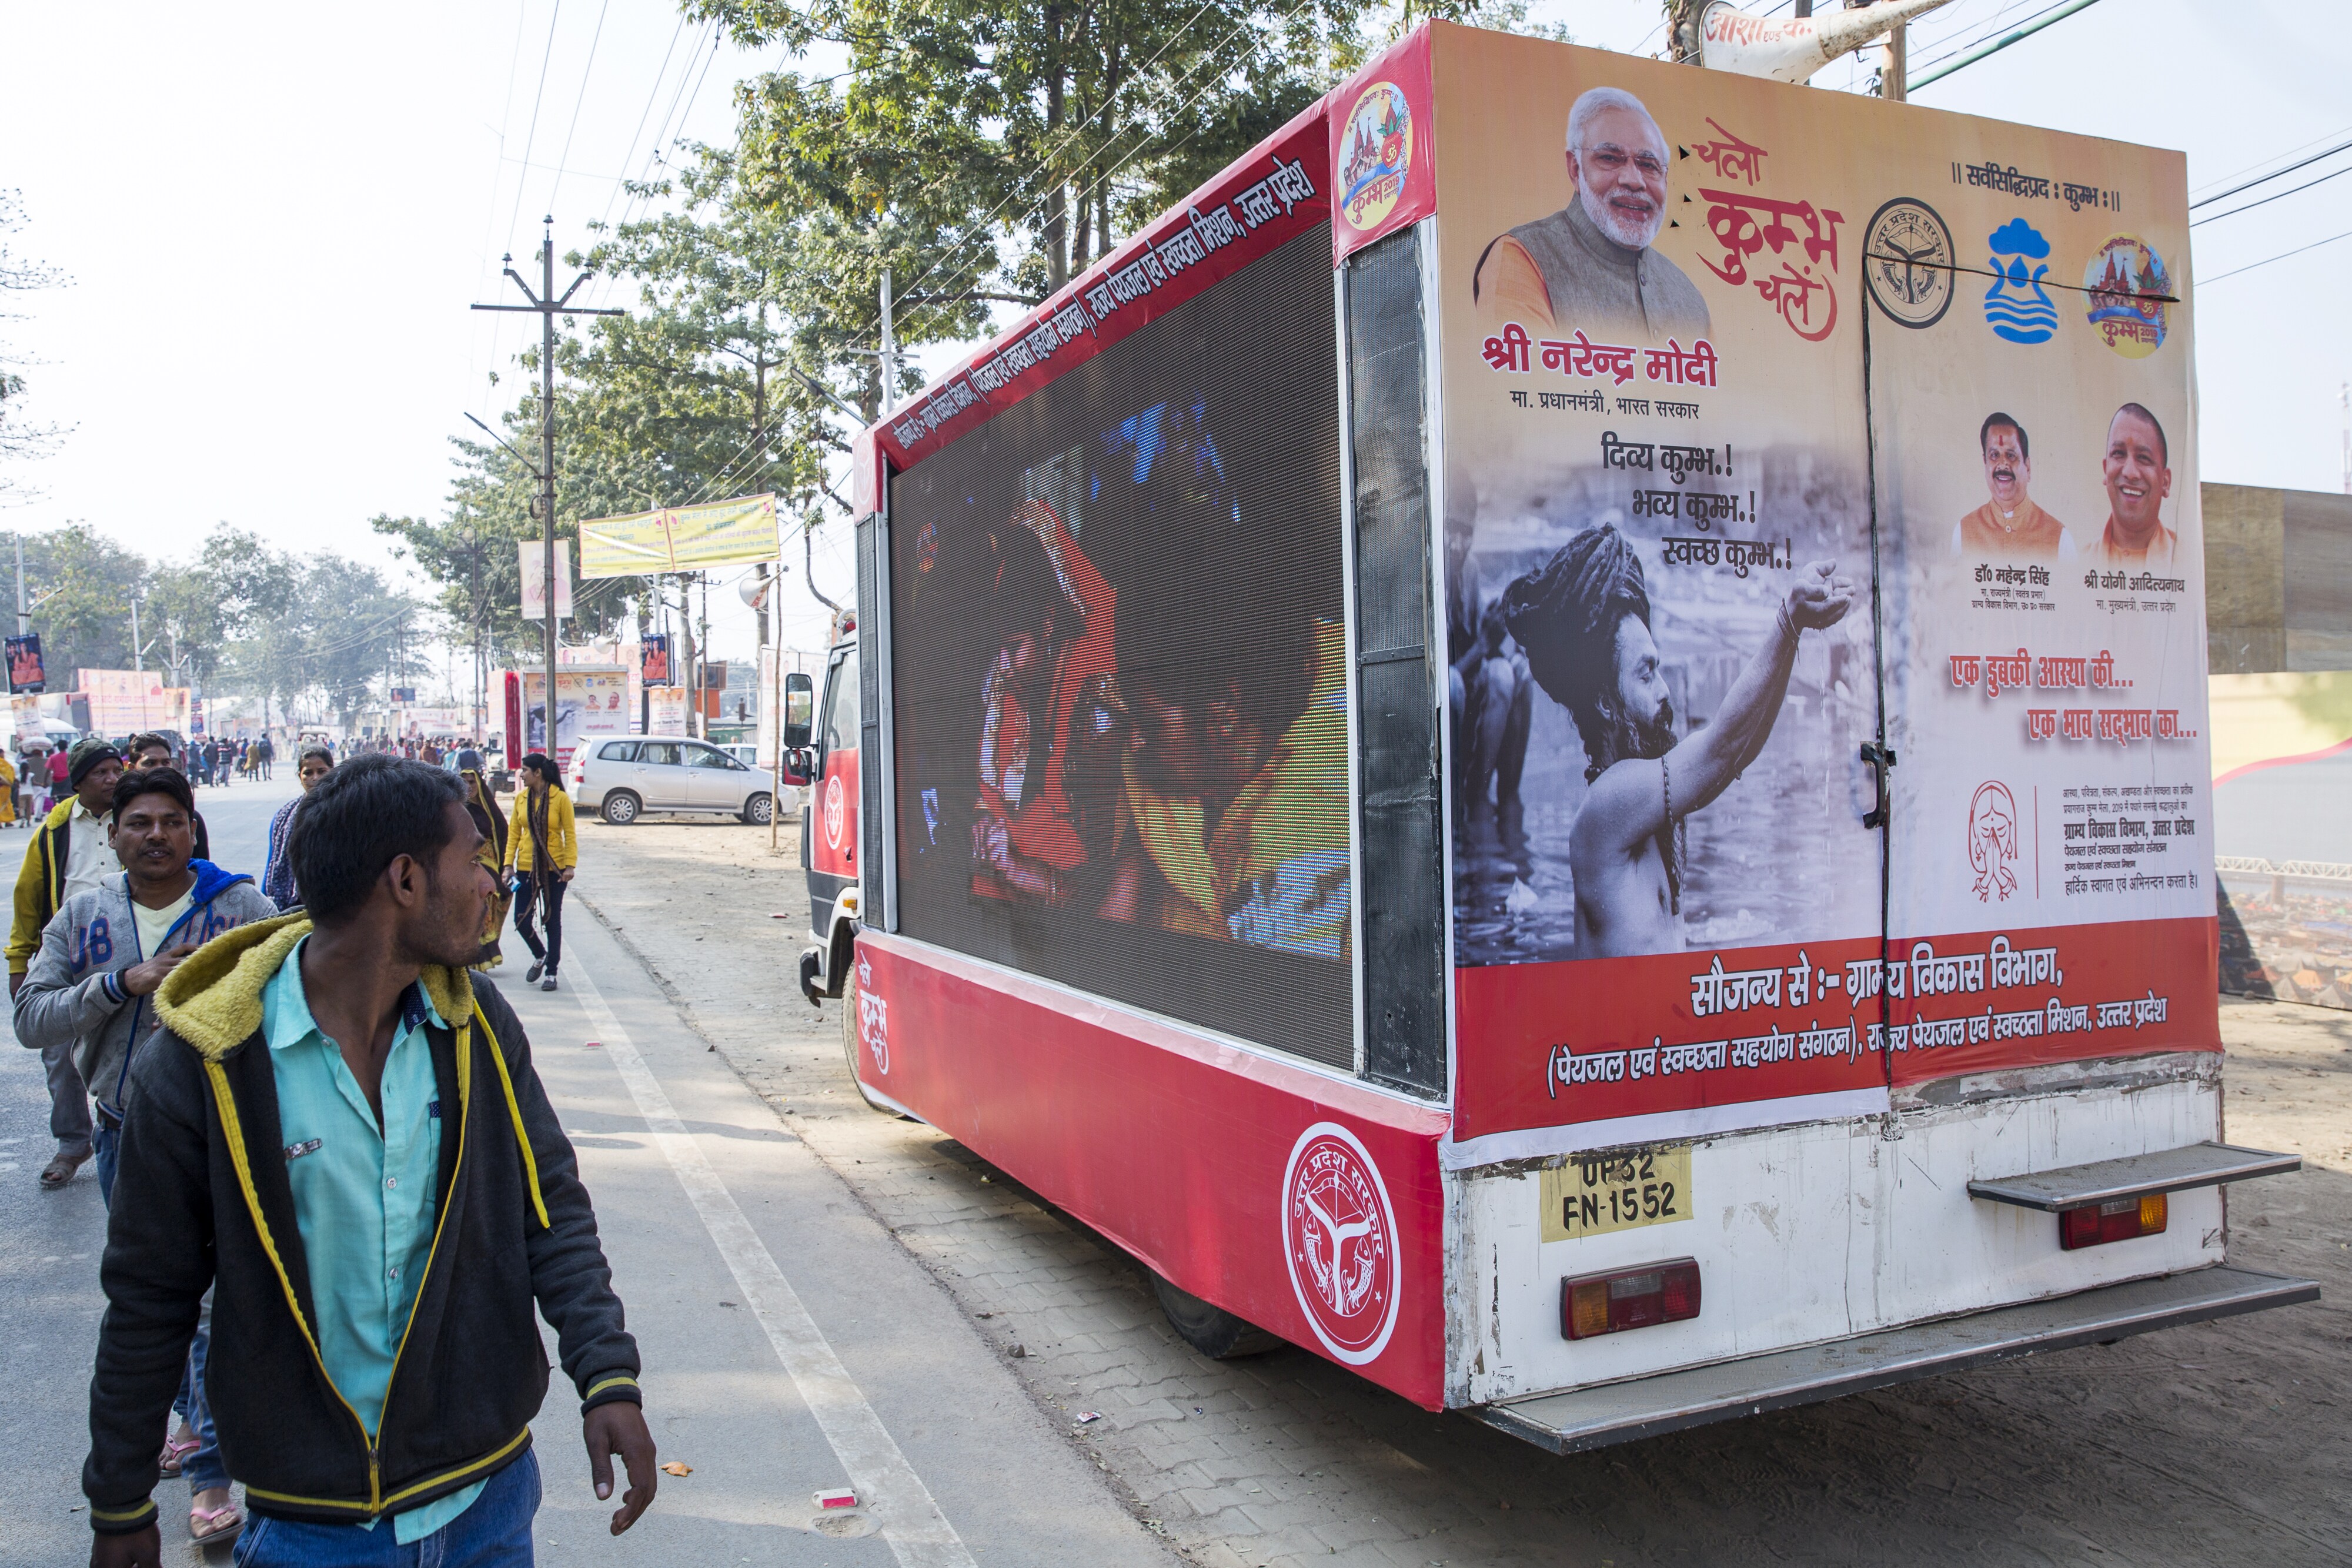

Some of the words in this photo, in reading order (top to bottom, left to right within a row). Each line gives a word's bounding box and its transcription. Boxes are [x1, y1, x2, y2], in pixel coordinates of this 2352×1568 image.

[1706, 11, 1765, 46] आशा
[1692, 118, 1768, 186] चलो
[1351, 172, 1390, 225] कुम्भ
[1384, 175, 1400, 193] 2019
[1696, 188, 1845, 286] कुम्भ
[1875, 224, 1890, 254] उत्तर
[1889, 210, 1920, 226] प्रदेश
[1923, 219, 1945, 263] सरकार
[927, 393, 960, 422] विकास
[1025, 315, 1063, 360] सहयोग
[1085, 284, 1115, 320] राज्य
[1104, 266, 1152, 305] पेयजल
[1140, 238, 1168, 288] एवं
[1188, 205, 1248, 254] मिशन,
[1233, 180, 1282, 230] उत्तर
[1268, 153, 1316, 218] प्रदेश
[1753, 262, 1838, 342] चलें
[2100, 319, 2145, 347] कुम्भ
[2140, 328, 2158, 337] 2019
[1481, 322, 1532, 374] श्री
[1540, 329, 1637, 387] नरेन्द्र
[1643, 339, 1719, 389] मोदी
[1509, 389, 1534, 410] मा.
[1538, 390, 1611, 415] प्रधानमंत्री,
[1616, 396, 1650, 417] भारत
[1655, 400, 1699, 420] सरकार
[1601, 431, 1655, 472] दिव्य
[1633, 489, 1680, 519] भव्य
[1662, 537, 1720, 566] स्वच्छ
[1996, 564, 2026, 586] महेन्द्र
[2029, 565, 2050, 586] सिंह
[2084, 569, 2098, 590] श्री
[2101, 570, 2126, 591] योगी
[2129, 571, 2185, 593] आदित्यनाथ
[1985, 597, 2001, 610] विकास
[2039, 603, 2056, 611] सरकार
[2096, 599, 2107, 611] मा.
[2141, 600, 2159, 613] उत्तर
[2159, 599, 2176, 614] प्रदेश
[1950, 655, 1980, 687] एक
[1985, 648, 2032, 698] डुबकी
[2039, 655, 2086, 688] आस्था
[2027, 709, 2057, 739] एक
[2063, 709, 2093, 739] भाव
[2098, 709, 2152, 747] सद्भाव
[2063, 788, 2080, 799] आस्था,
[2112, 803, 2123, 813] 2019
[2181, 801, 2187, 810] का
[2063, 823, 2086, 840] ग्राम्य
[2088, 818, 2117, 838] विकास
[2119, 817, 2149, 840] विभाग,
[2152, 820, 2172, 836] उत्तर
[2174, 815, 2195, 835] प्रदेश
[2064, 844, 2086, 857] पेयजल
[2087, 842, 2097, 857] एवं
[2122, 841, 2144, 854] सहयोग
[2146, 840, 2167, 853] संगठन
[2077, 861, 2094, 871] पेयजल
[2122, 858, 2136, 868] मिशन
[2065, 875, 2088, 895] हार्दिक
[2090, 878, 2113, 893] स्वागत
[2116, 874, 2127, 894] एवं
[2129, 872, 2164, 891] अभिनन्दन
[2166, 875, 2186, 888] करता
[858, 950, 871, 988] चलो
[1691, 954, 1782, 1016] सौजन्य
[1788, 950, 1812, 1007] से
[1910, 941, 1986, 998] विकास
[1989, 935, 2063, 989] विभाग,
[859, 989, 887, 1043] कुम्भ
[870, 1030, 889, 1075] चलें
[1546, 1045, 1628, 1099] (पेयजल
[1629, 1037, 1661, 1079] एवं
[1661, 1041, 1728, 1074] स्वच्छता
[1731, 1024, 1795, 1068] सहयोग
[1799, 1016, 1863, 1065] संगठन),
[1912, 1014, 1966, 1049] पेयजल
[1968, 1005, 1993, 1045] एवं
[2047, 997, 2093, 1034] मिशन,
[2096, 999, 2133, 1029] उत्तर
[2134, 989, 2168, 1029] प्रदेश
[1294, 1167, 1312, 1218] उत्तर
[1310, 1146, 1348, 1172] प्रदेश
[1352, 1165, 1384, 1260] सरकार
